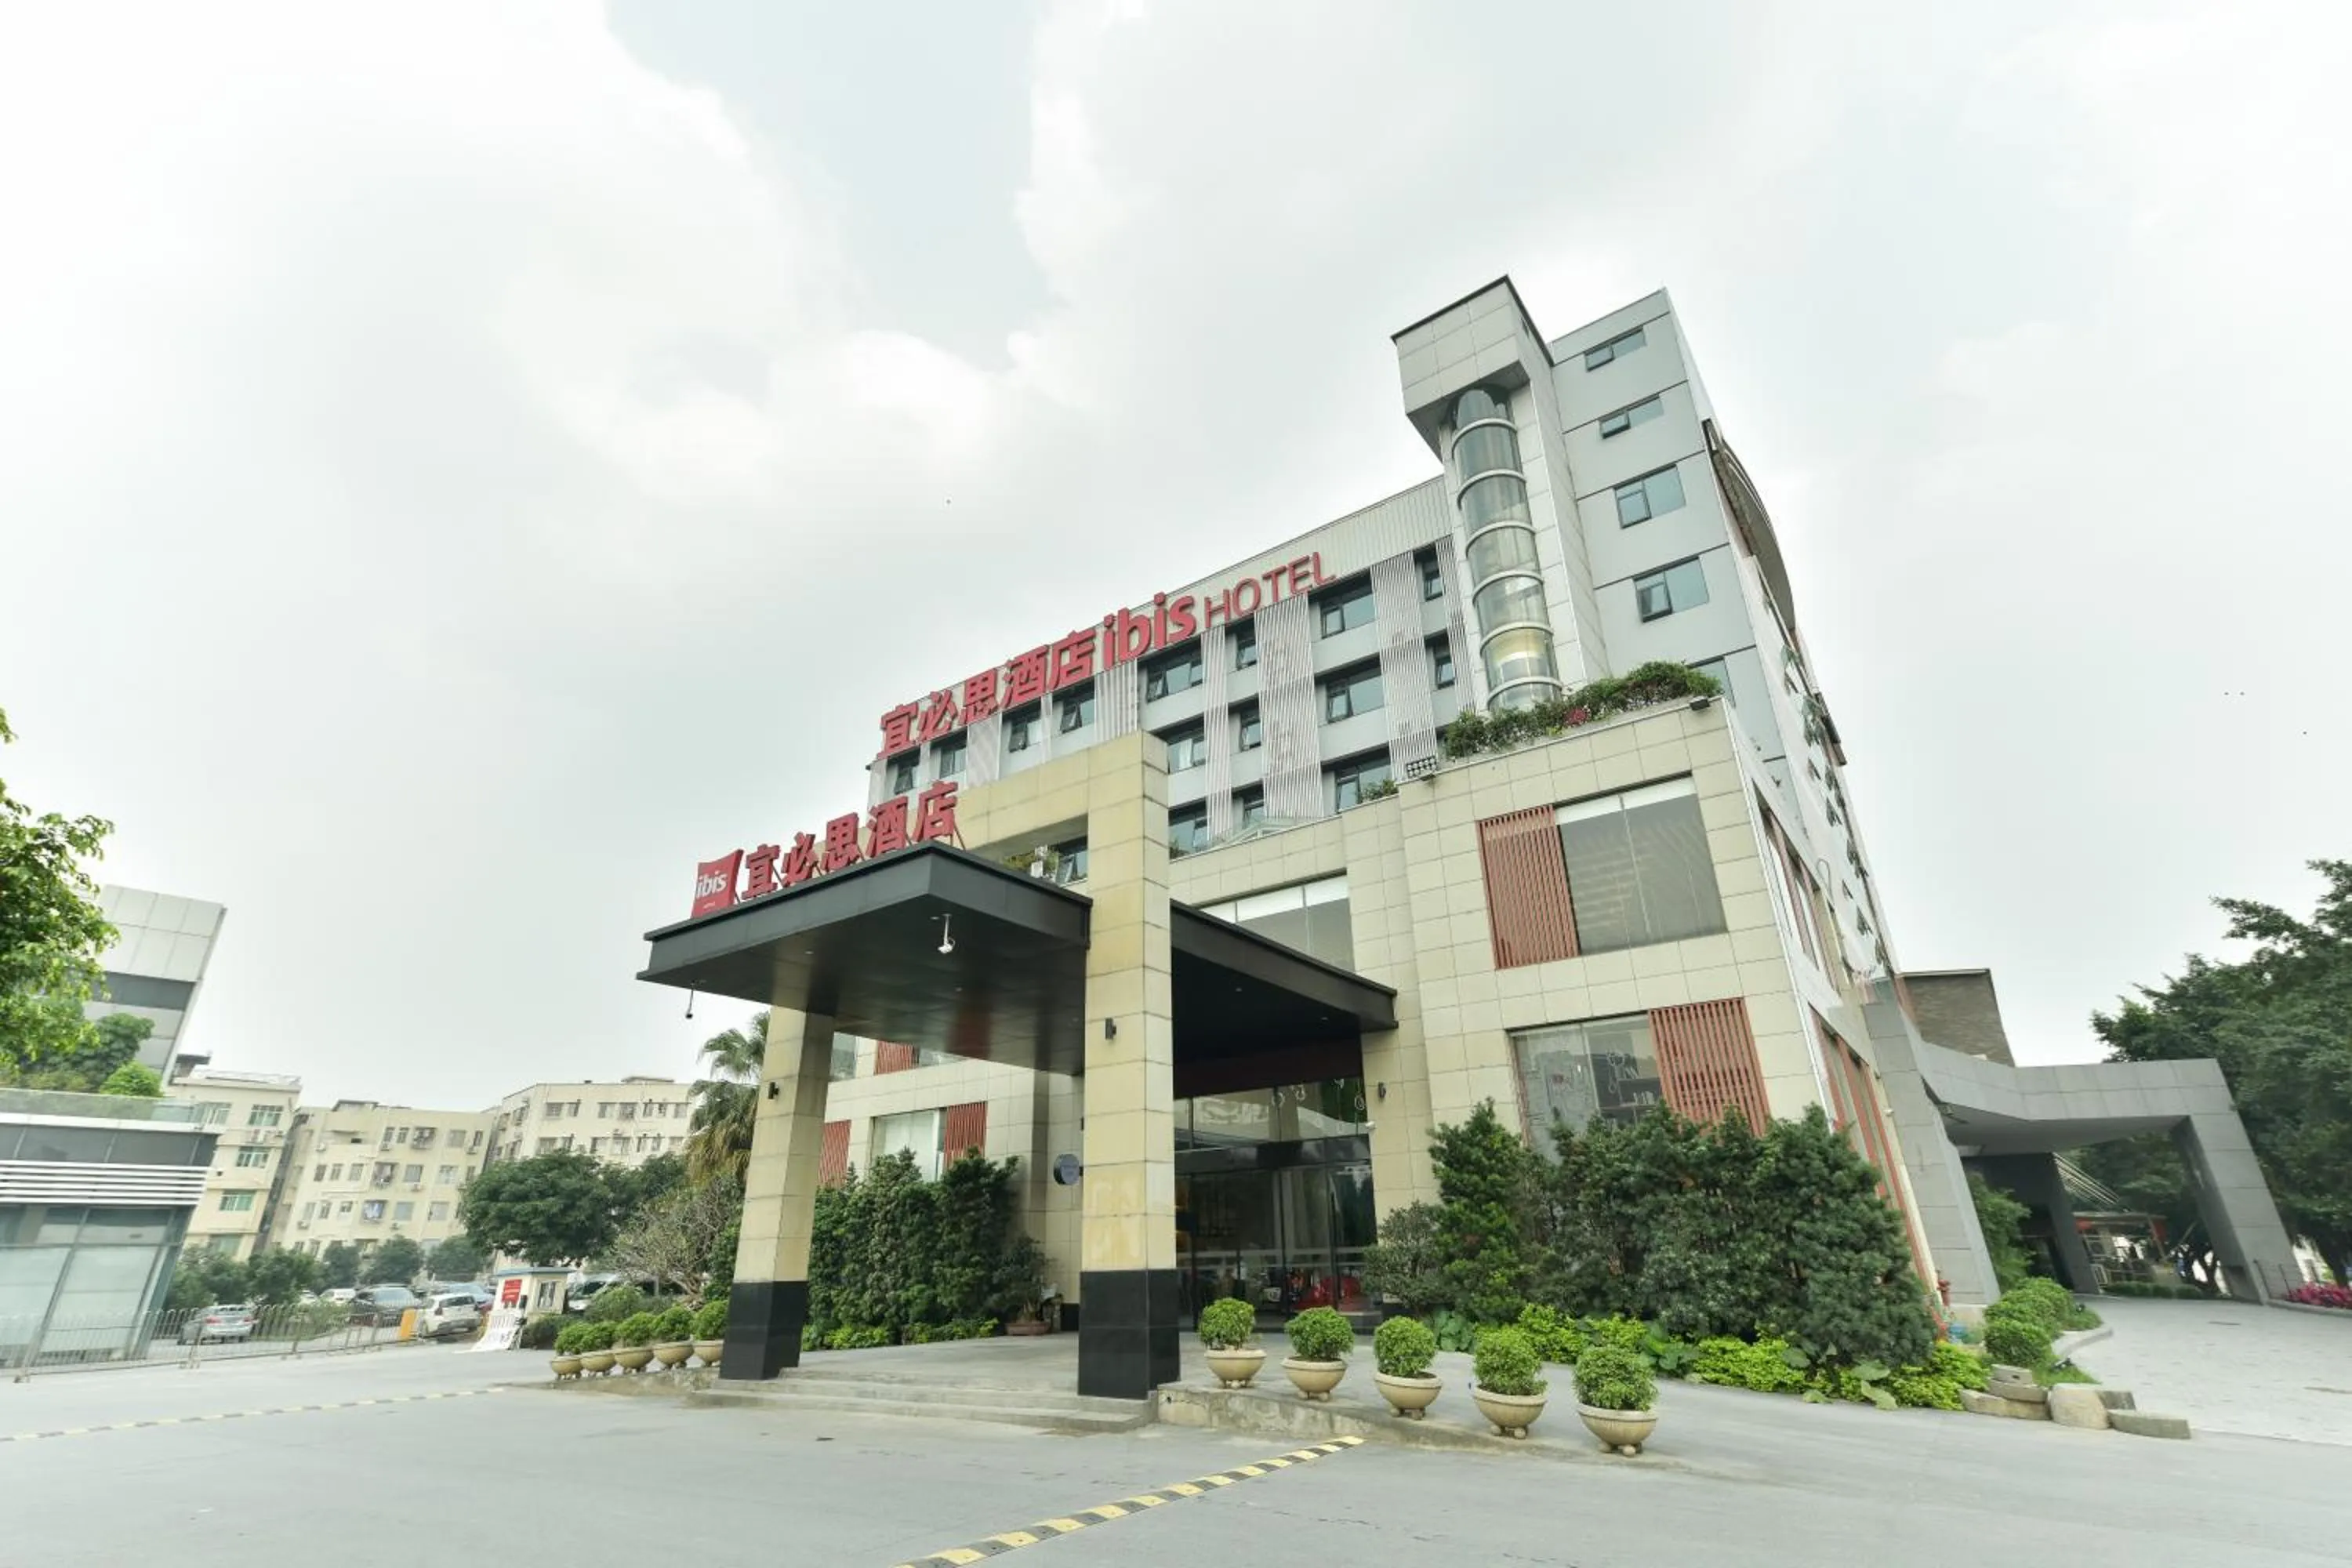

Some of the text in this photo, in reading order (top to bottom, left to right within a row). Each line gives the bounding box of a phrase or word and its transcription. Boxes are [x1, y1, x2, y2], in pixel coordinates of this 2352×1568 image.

[877, 551, 1337, 760] 宜必思酒店 ibis HOTEL
[696, 870, 728, 898] ibis
[741, 780, 959, 900] 宜必思酒店
